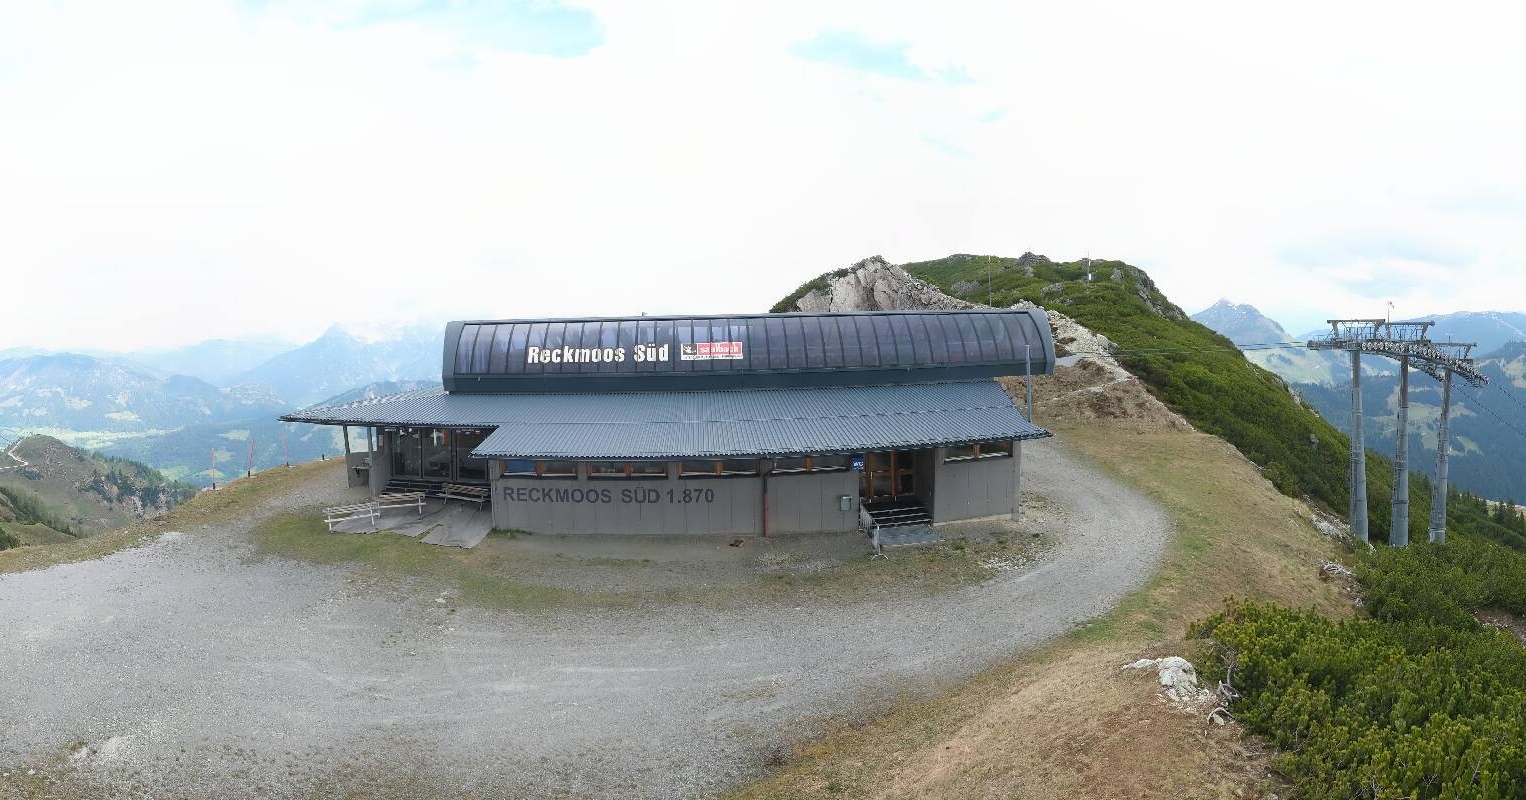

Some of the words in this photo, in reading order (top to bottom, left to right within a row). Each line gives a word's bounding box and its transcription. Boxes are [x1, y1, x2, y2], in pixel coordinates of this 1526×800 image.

[527, 345, 626, 364] Reckmoos
[633, 343, 669, 362] Süd
[503, 486, 612, 504] RECKMOOS
[620, 486, 661, 504] SÜD
[666, 488, 715, 504] 1.870
